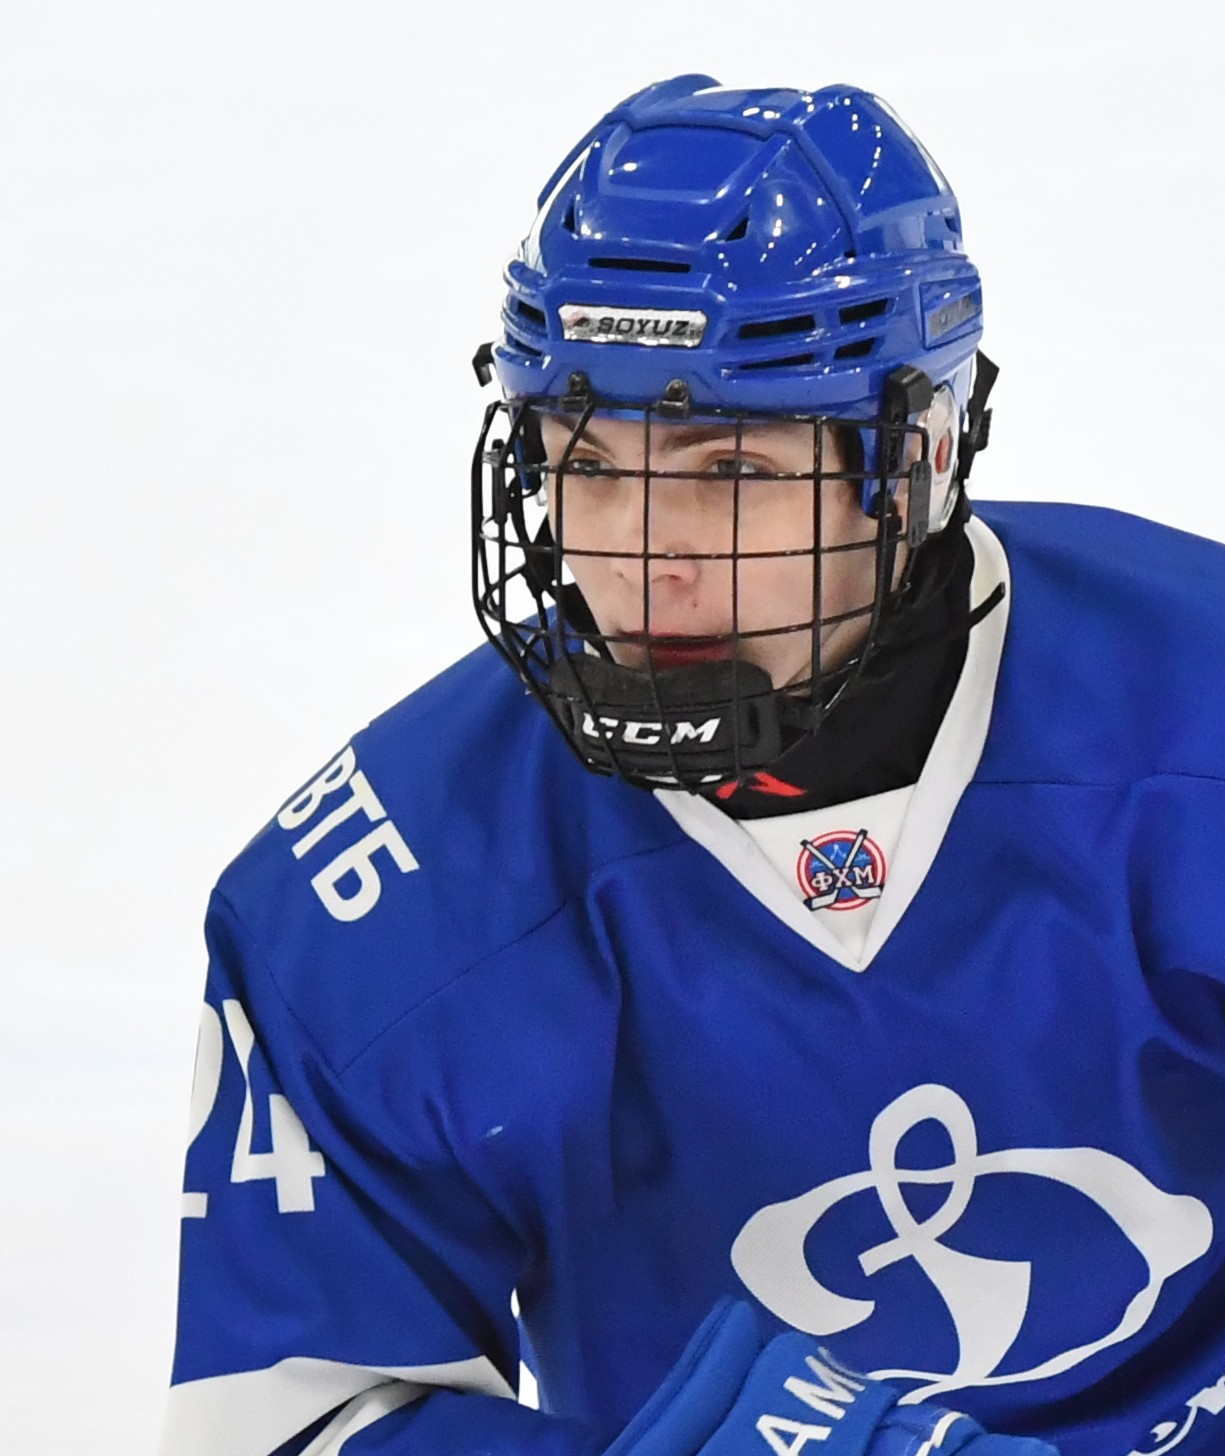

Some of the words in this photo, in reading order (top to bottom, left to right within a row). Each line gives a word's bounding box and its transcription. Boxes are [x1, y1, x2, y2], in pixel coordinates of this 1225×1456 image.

[598, 316, 690, 337] SOYUZ
[583, 702, 721, 745] CCM
[277, 744, 421, 922] ВТБ
[811, 864, 875, 892] ФХМ
